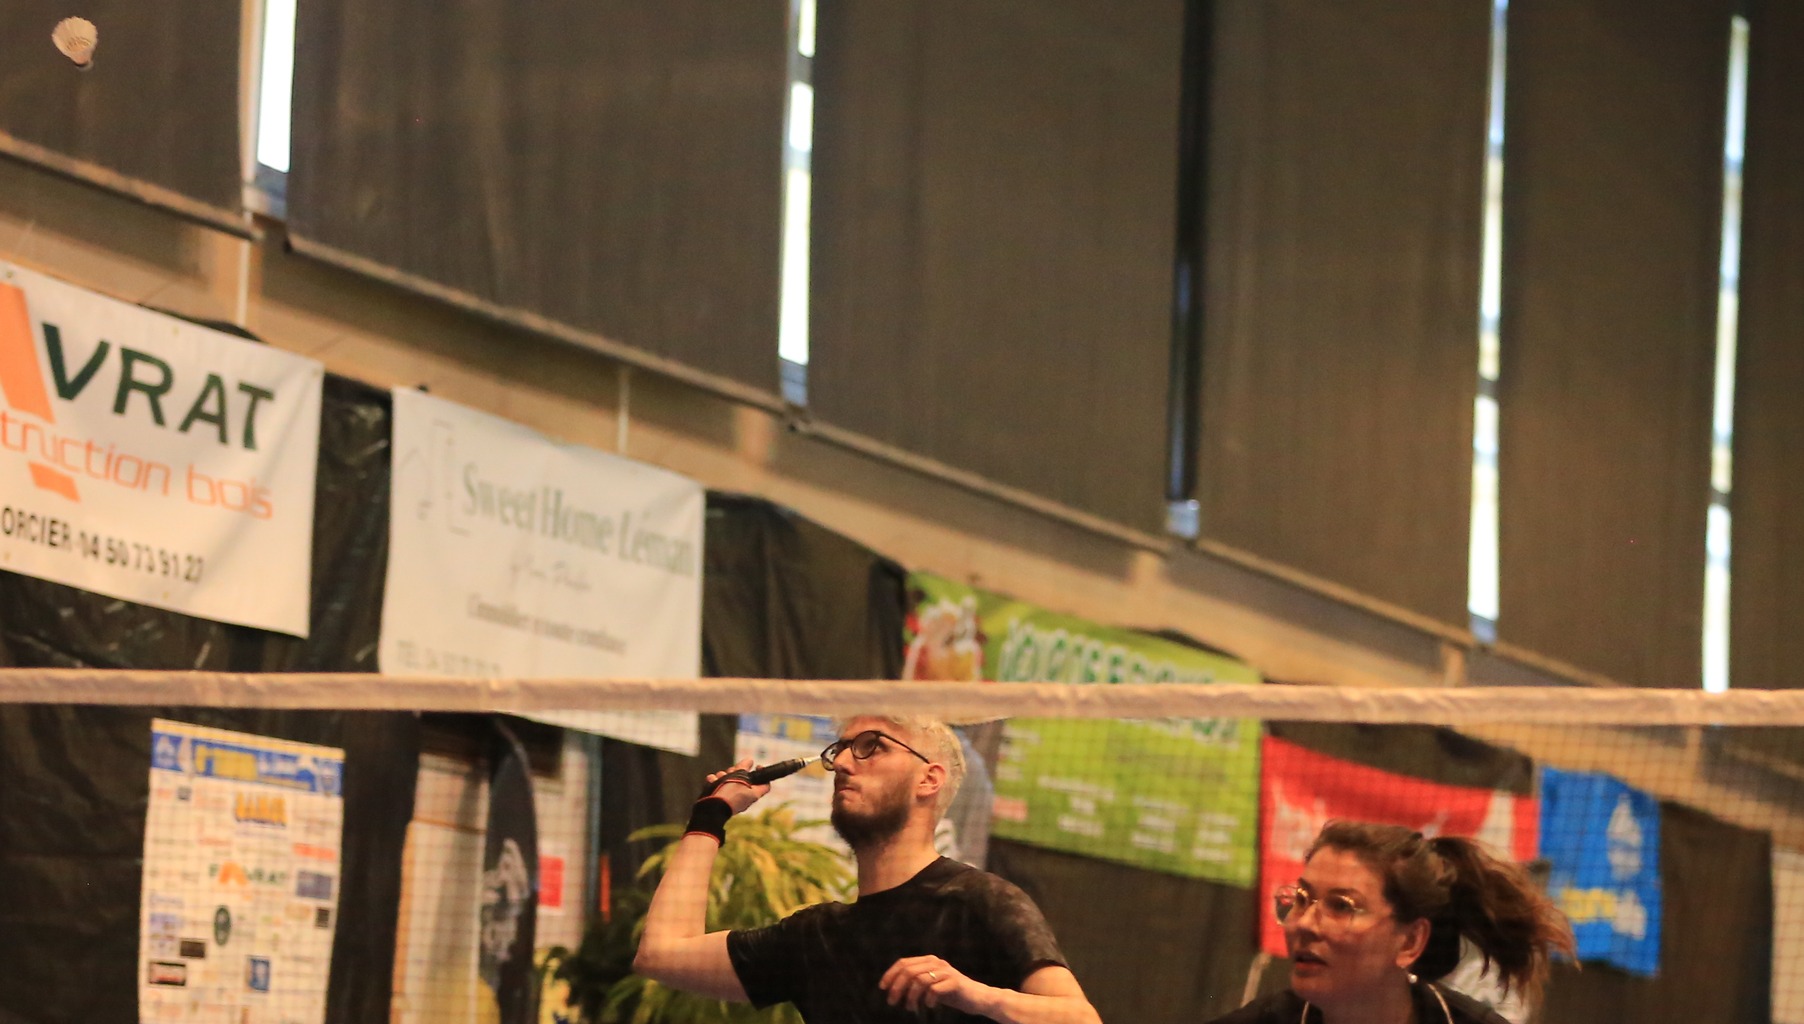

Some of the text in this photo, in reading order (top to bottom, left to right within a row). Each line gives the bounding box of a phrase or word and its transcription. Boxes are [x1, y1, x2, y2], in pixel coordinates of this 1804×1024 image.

[186, 462, 274, 520] bois
[463, 462, 537, 531] Sweet
[540, 485, 615, 555] Home
[2, 507, 73, 552] ORCIER
